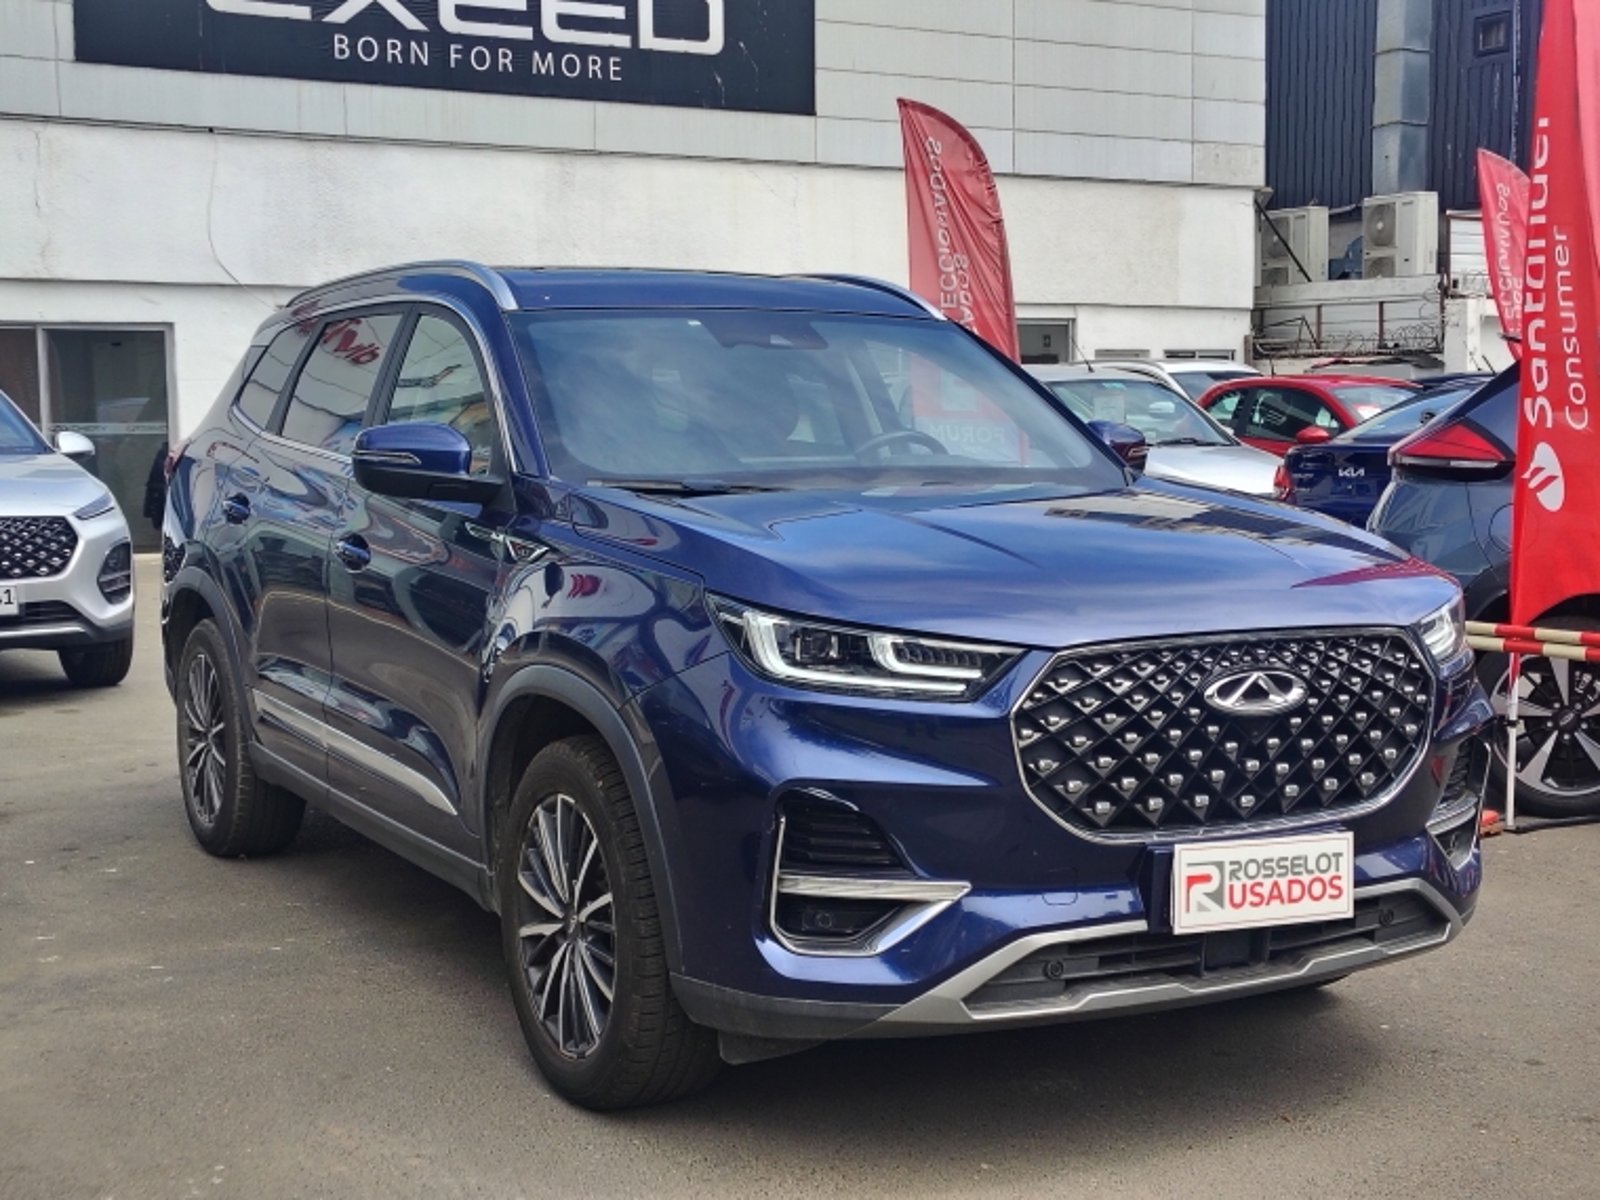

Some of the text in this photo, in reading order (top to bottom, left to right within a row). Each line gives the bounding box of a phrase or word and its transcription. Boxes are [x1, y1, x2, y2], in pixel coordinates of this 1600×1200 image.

[333, 34, 623, 81] BORN FOR MORE
[1553, 225, 1589, 431] Consumer
[1338, 467, 1365, 477] KIA
[1, 588, 14, 605] 1
[1229, 852, 1343, 882] ROSSELOT
[1228, 875, 1344, 910] USADOS
